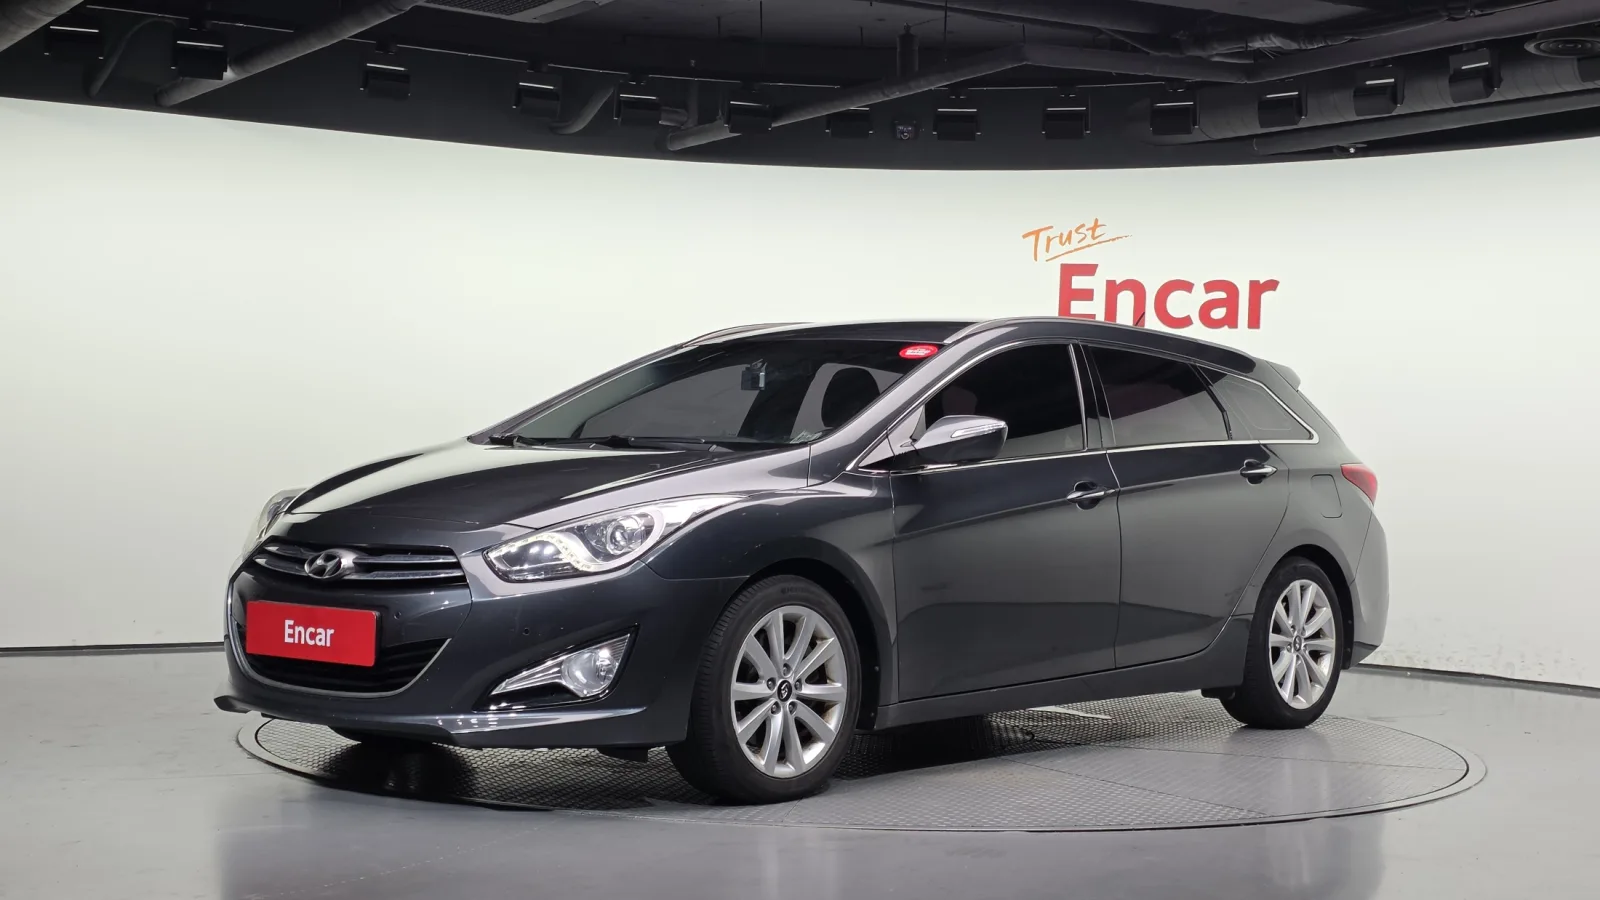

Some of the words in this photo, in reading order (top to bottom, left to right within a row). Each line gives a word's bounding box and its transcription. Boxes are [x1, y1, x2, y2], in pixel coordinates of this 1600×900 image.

[1022, 218, 1108, 262] Trust
[1058, 263, 1280, 329] Encar
[284, 619, 335, 647] Encar
